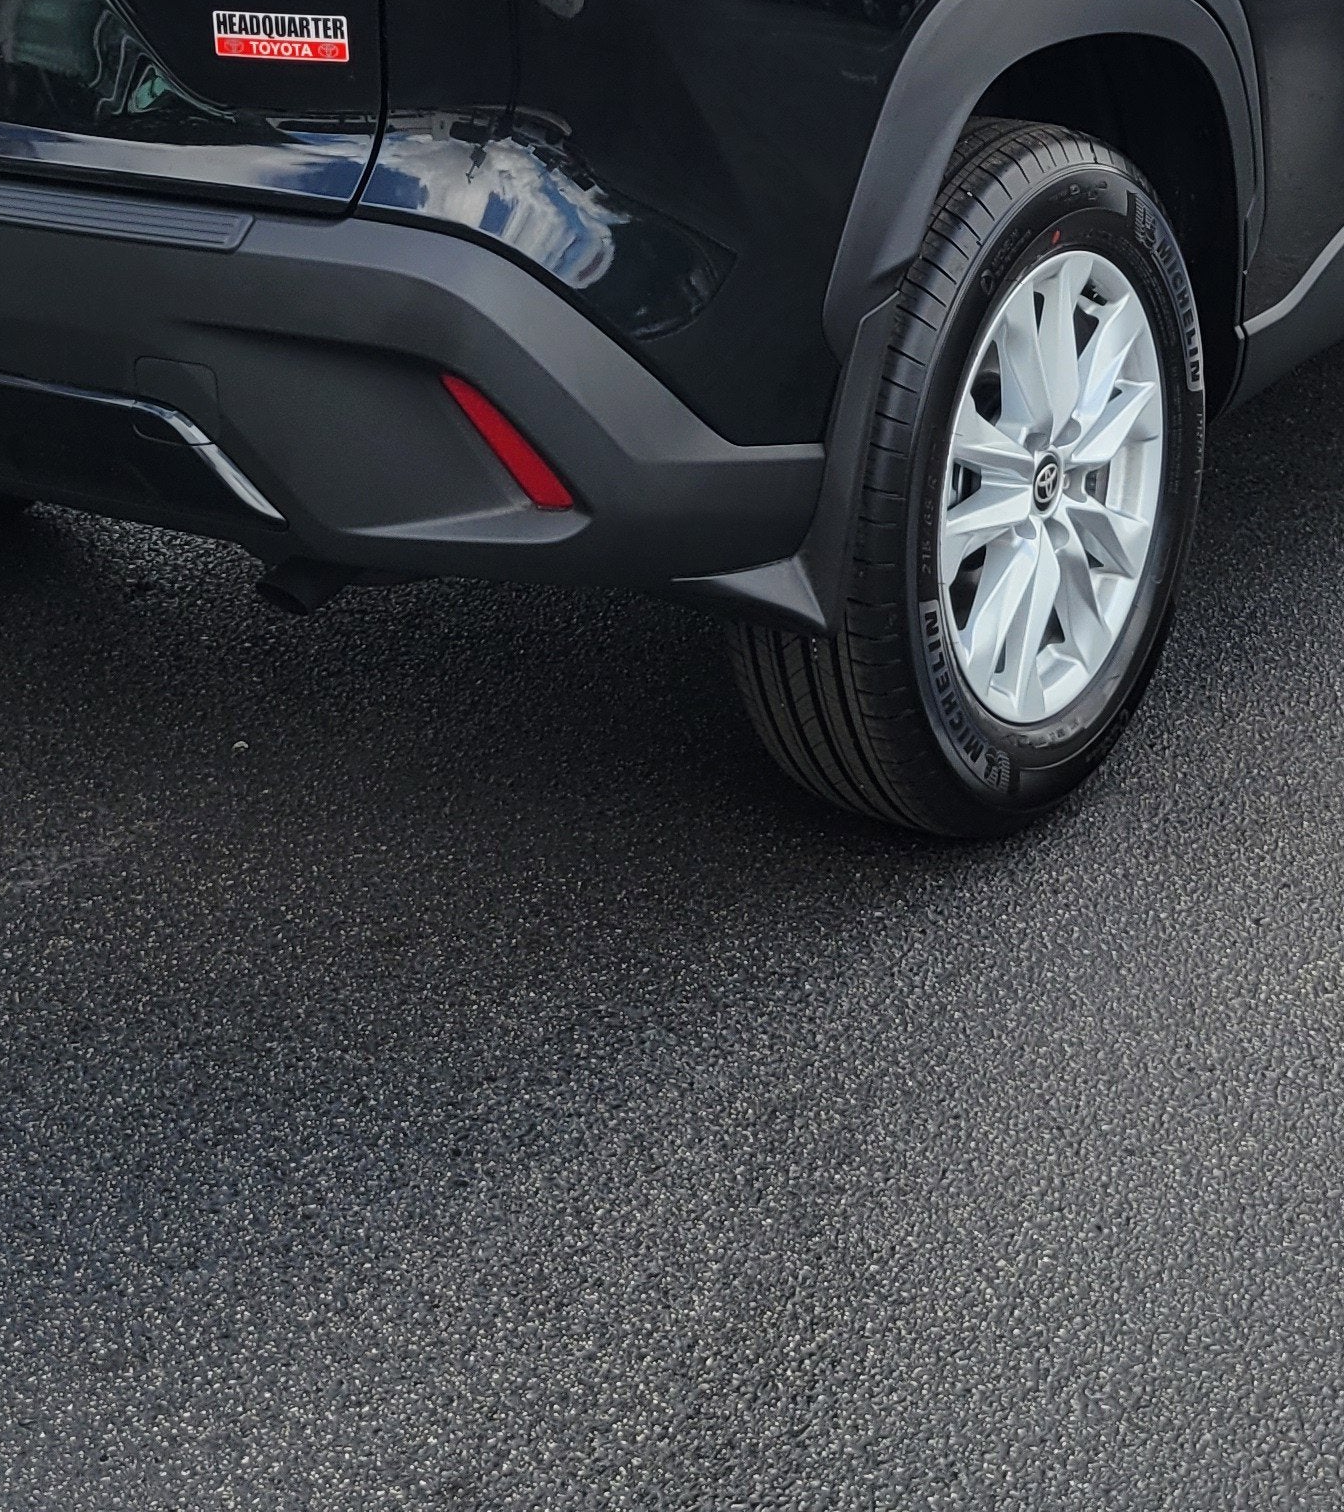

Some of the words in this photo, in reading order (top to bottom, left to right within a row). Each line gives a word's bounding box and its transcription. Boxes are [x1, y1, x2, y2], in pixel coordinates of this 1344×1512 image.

[216, 13, 346, 40] HEADQUARTER
[249, 40, 314, 58] TOYOTA
[1156, 240, 1201, 385] MICHELIN
[922, 609, 986, 764] MICHELIN
